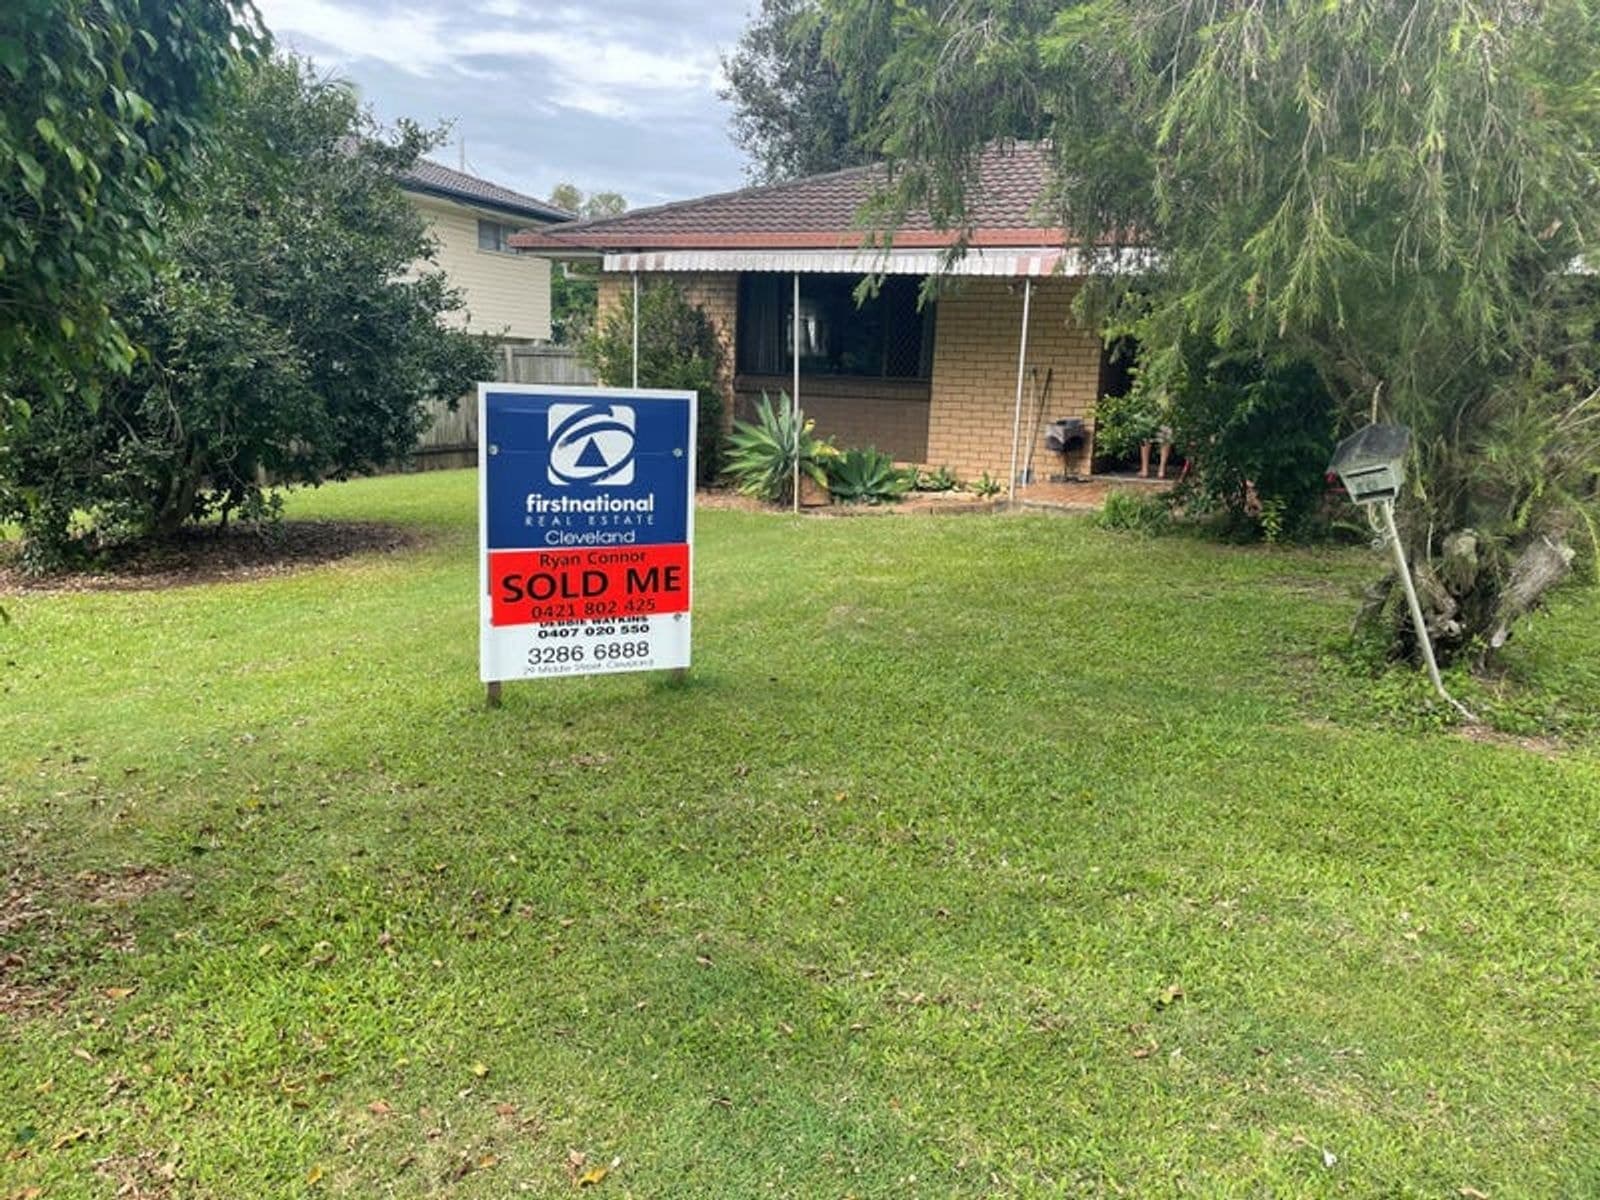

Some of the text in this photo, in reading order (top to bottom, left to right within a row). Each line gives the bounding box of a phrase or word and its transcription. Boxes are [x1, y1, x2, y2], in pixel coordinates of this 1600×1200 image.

[527, 493, 654, 513] firstnational
[525, 514, 654, 527] REAL ESTATE
[545, 529, 636, 545] Cleveland
[540, 551, 646, 569] Ryan Connor
[502, 566, 681, 603] SOLD ME
[532, 598, 656, 619] 0421 802 425
[538, 624, 650, 639] 0407 020 550
[528, 641, 650, 664] 3286 6888
